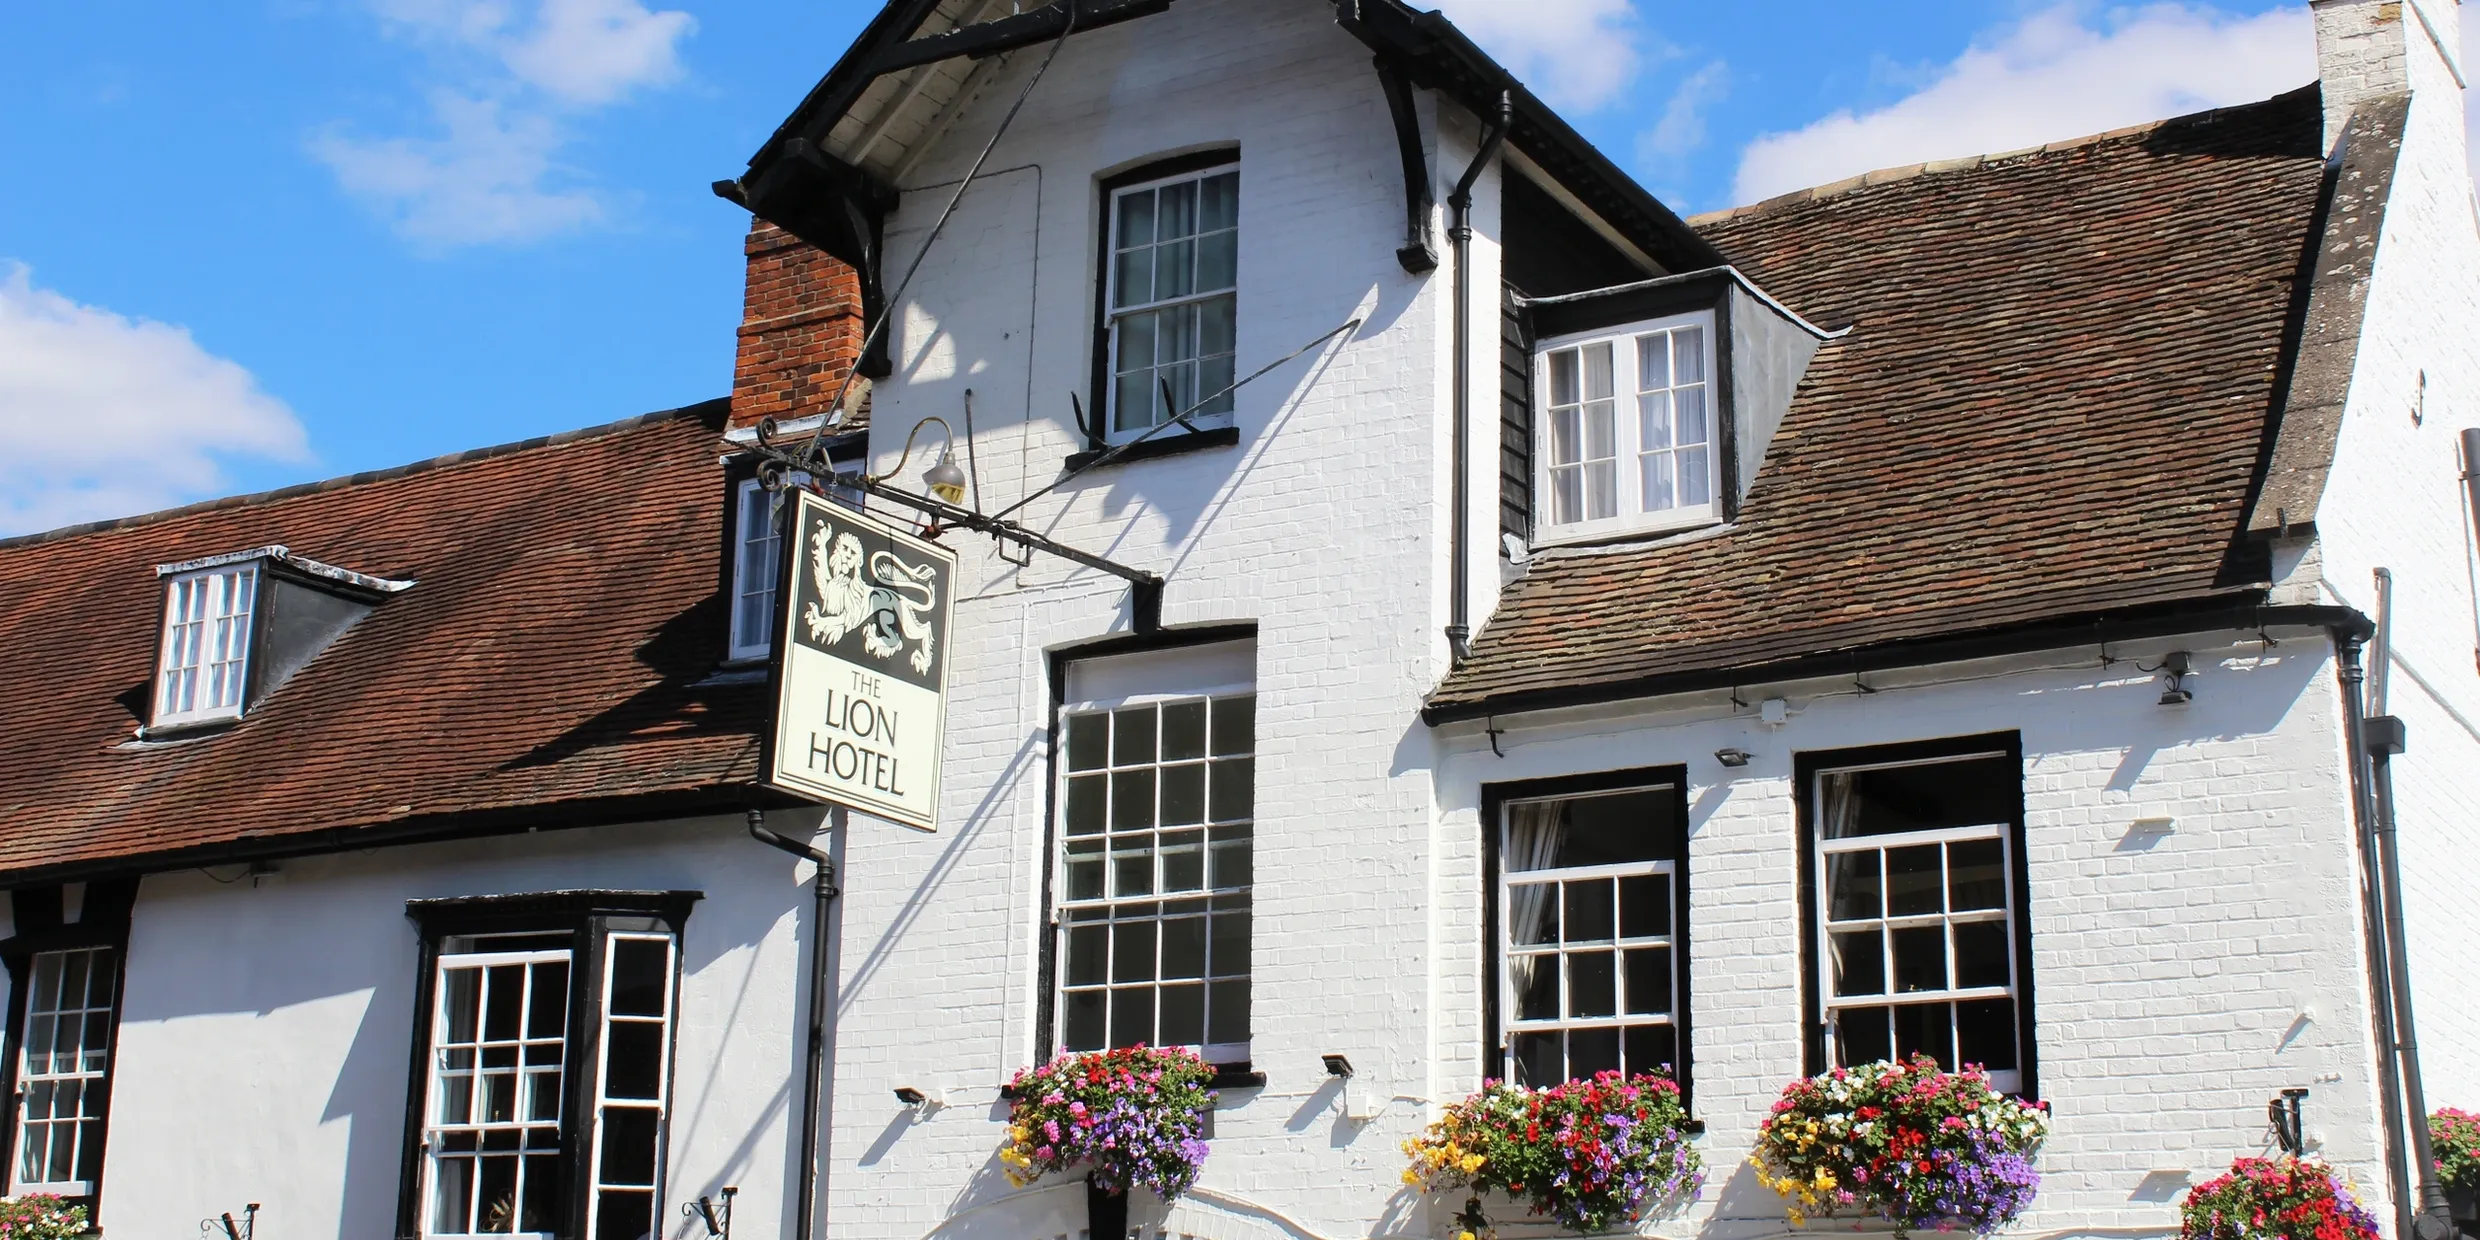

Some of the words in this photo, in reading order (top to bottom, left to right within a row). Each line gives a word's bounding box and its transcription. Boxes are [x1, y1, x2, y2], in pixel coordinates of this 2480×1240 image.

[852, 670, 881, 698] THE
[825, 689, 898, 747] LION
[808, 732, 904, 796] HOTEL
